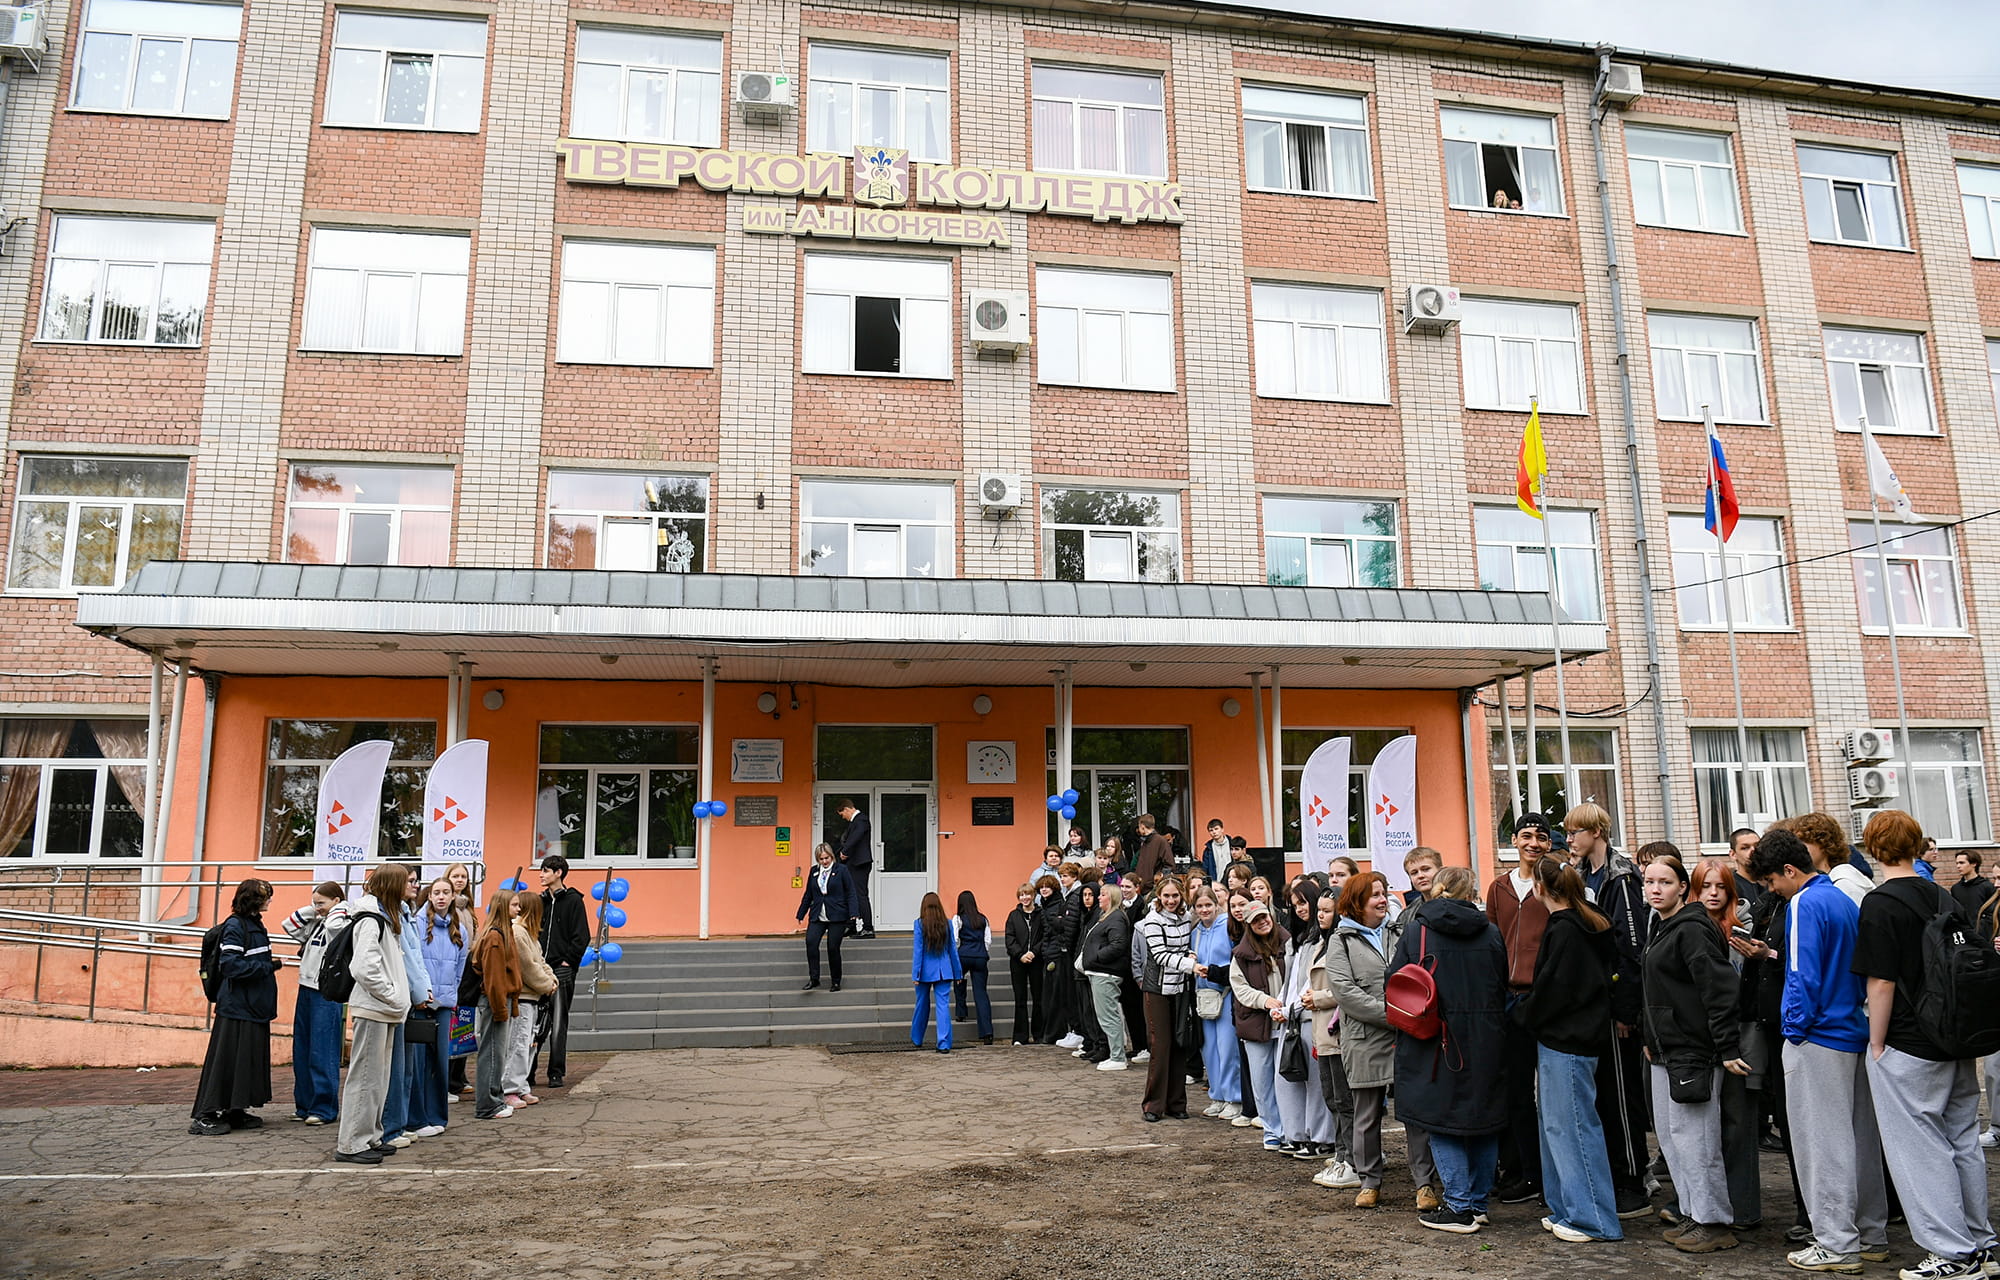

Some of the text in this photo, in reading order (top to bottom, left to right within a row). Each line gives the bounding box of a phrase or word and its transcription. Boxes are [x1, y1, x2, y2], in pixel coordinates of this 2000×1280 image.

[560, 143, 1180, 219] ТВЕРСКОЙ КОЛЛЕДЖ
[860, 212, 1005, 241] КОНЯЕВА
[1385, 831, 1411, 839] РАБОТА
[443, 839, 480, 849] РАБОТА
[1318, 841, 1346, 849] РОССИИ
[442, 848, 482, 858] РОССИИ
[1626, 910, 1637, 946] FASHION
